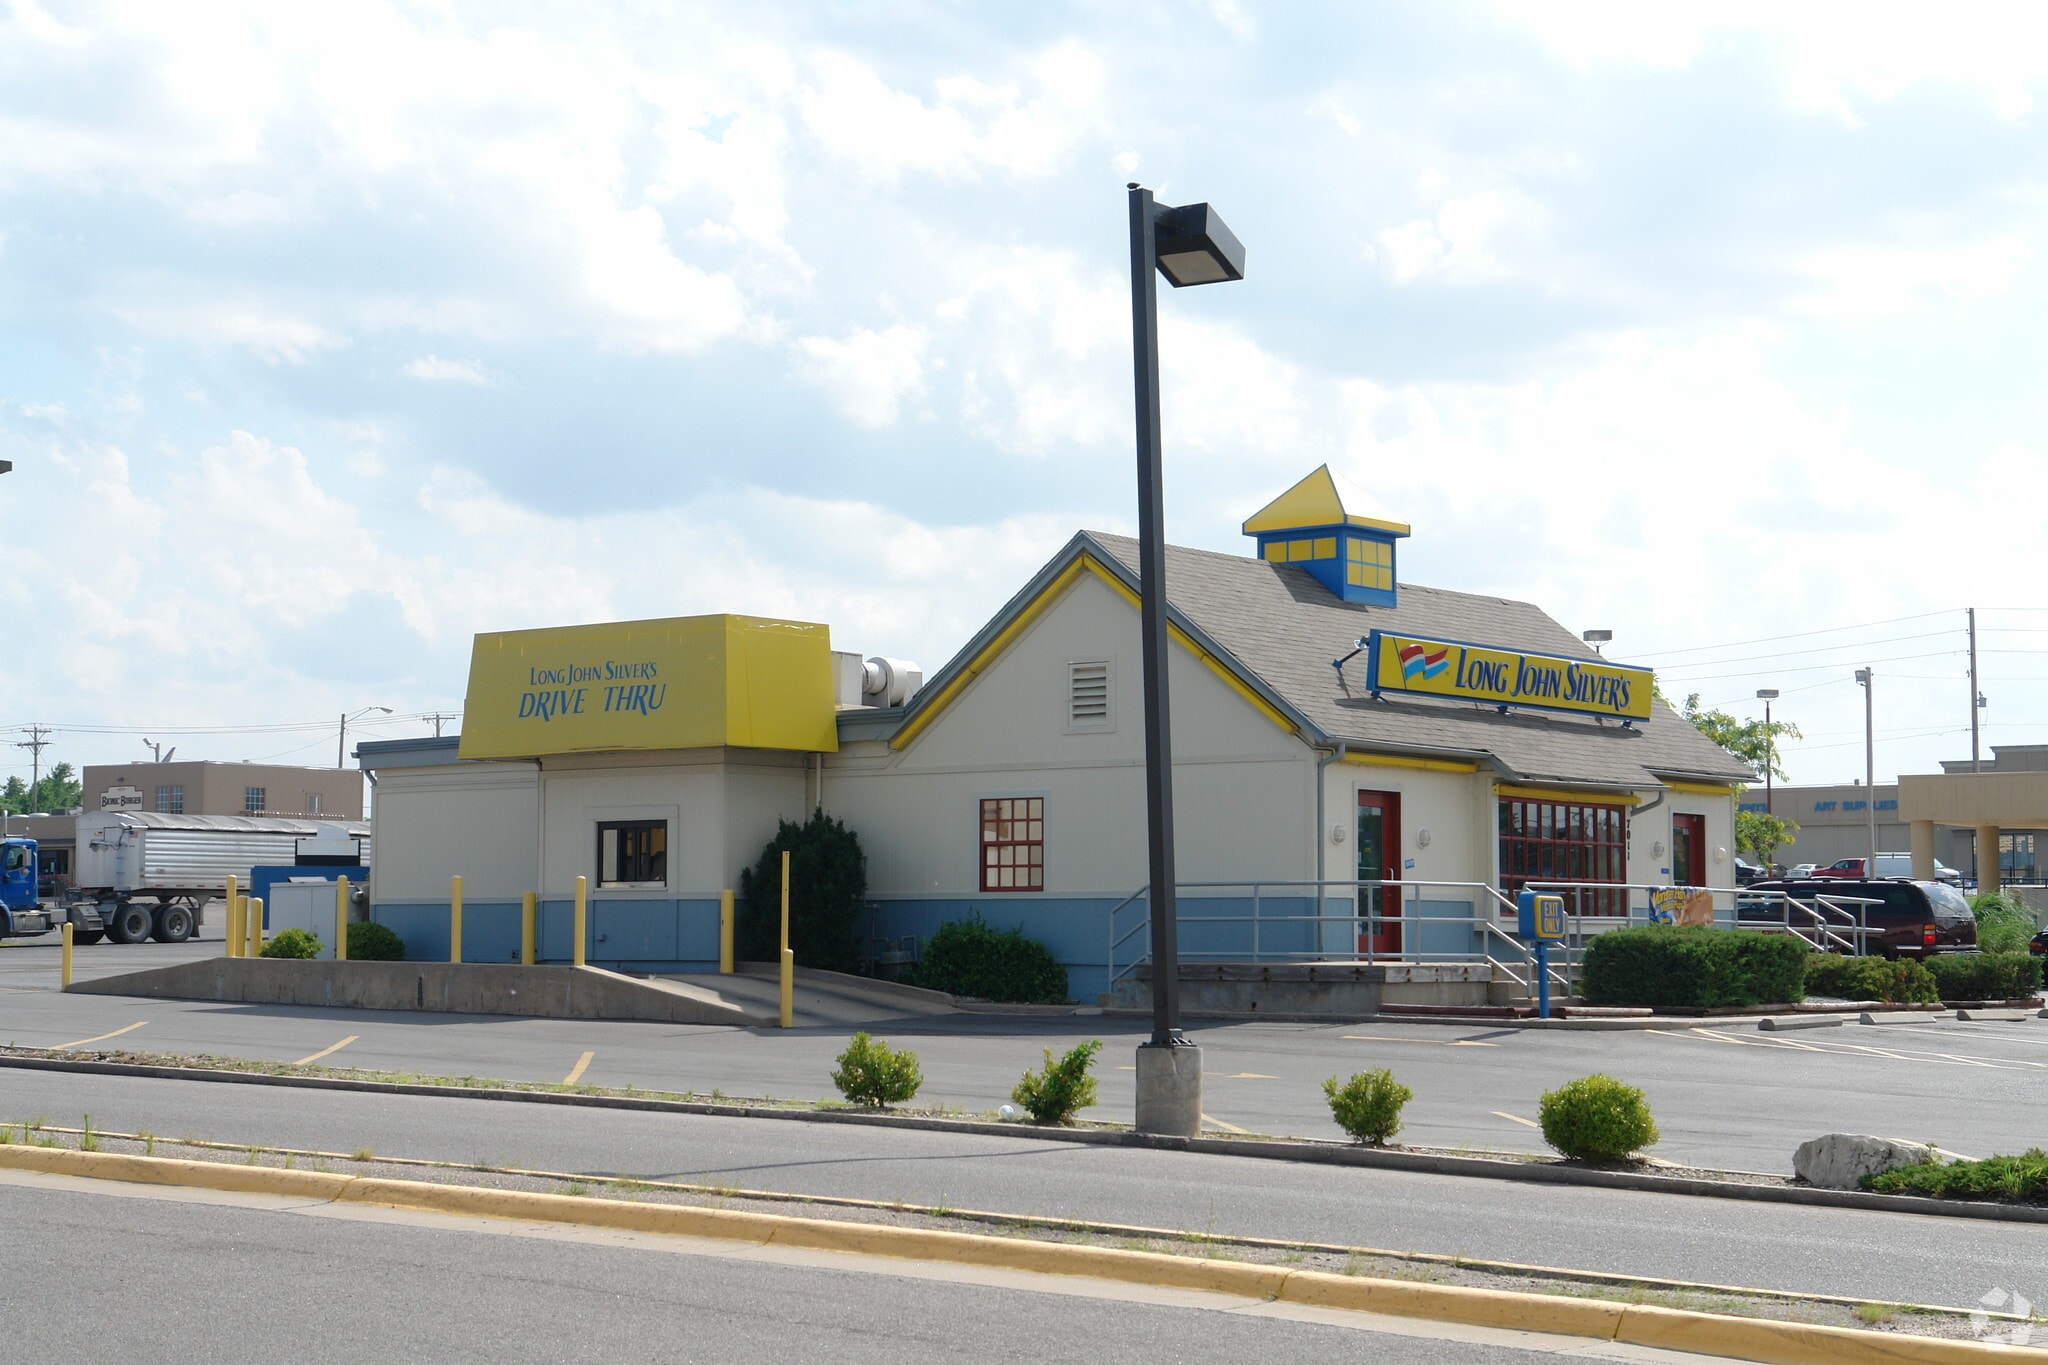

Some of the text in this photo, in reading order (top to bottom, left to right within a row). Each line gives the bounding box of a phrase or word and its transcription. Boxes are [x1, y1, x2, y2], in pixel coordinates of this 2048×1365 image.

[530, 660, 658, 686] LONG JOHN SILVER'S
[1455, 647, 1631, 712] LONG JOHN SILVER'S
[518, 683, 667, 722] DRIVE THRU
[1814, 800, 1898, 811] ART SUPLIES
[1544, 901, 1559, 916] EXIT
[1544, 918, 1560, 933] ONLY
